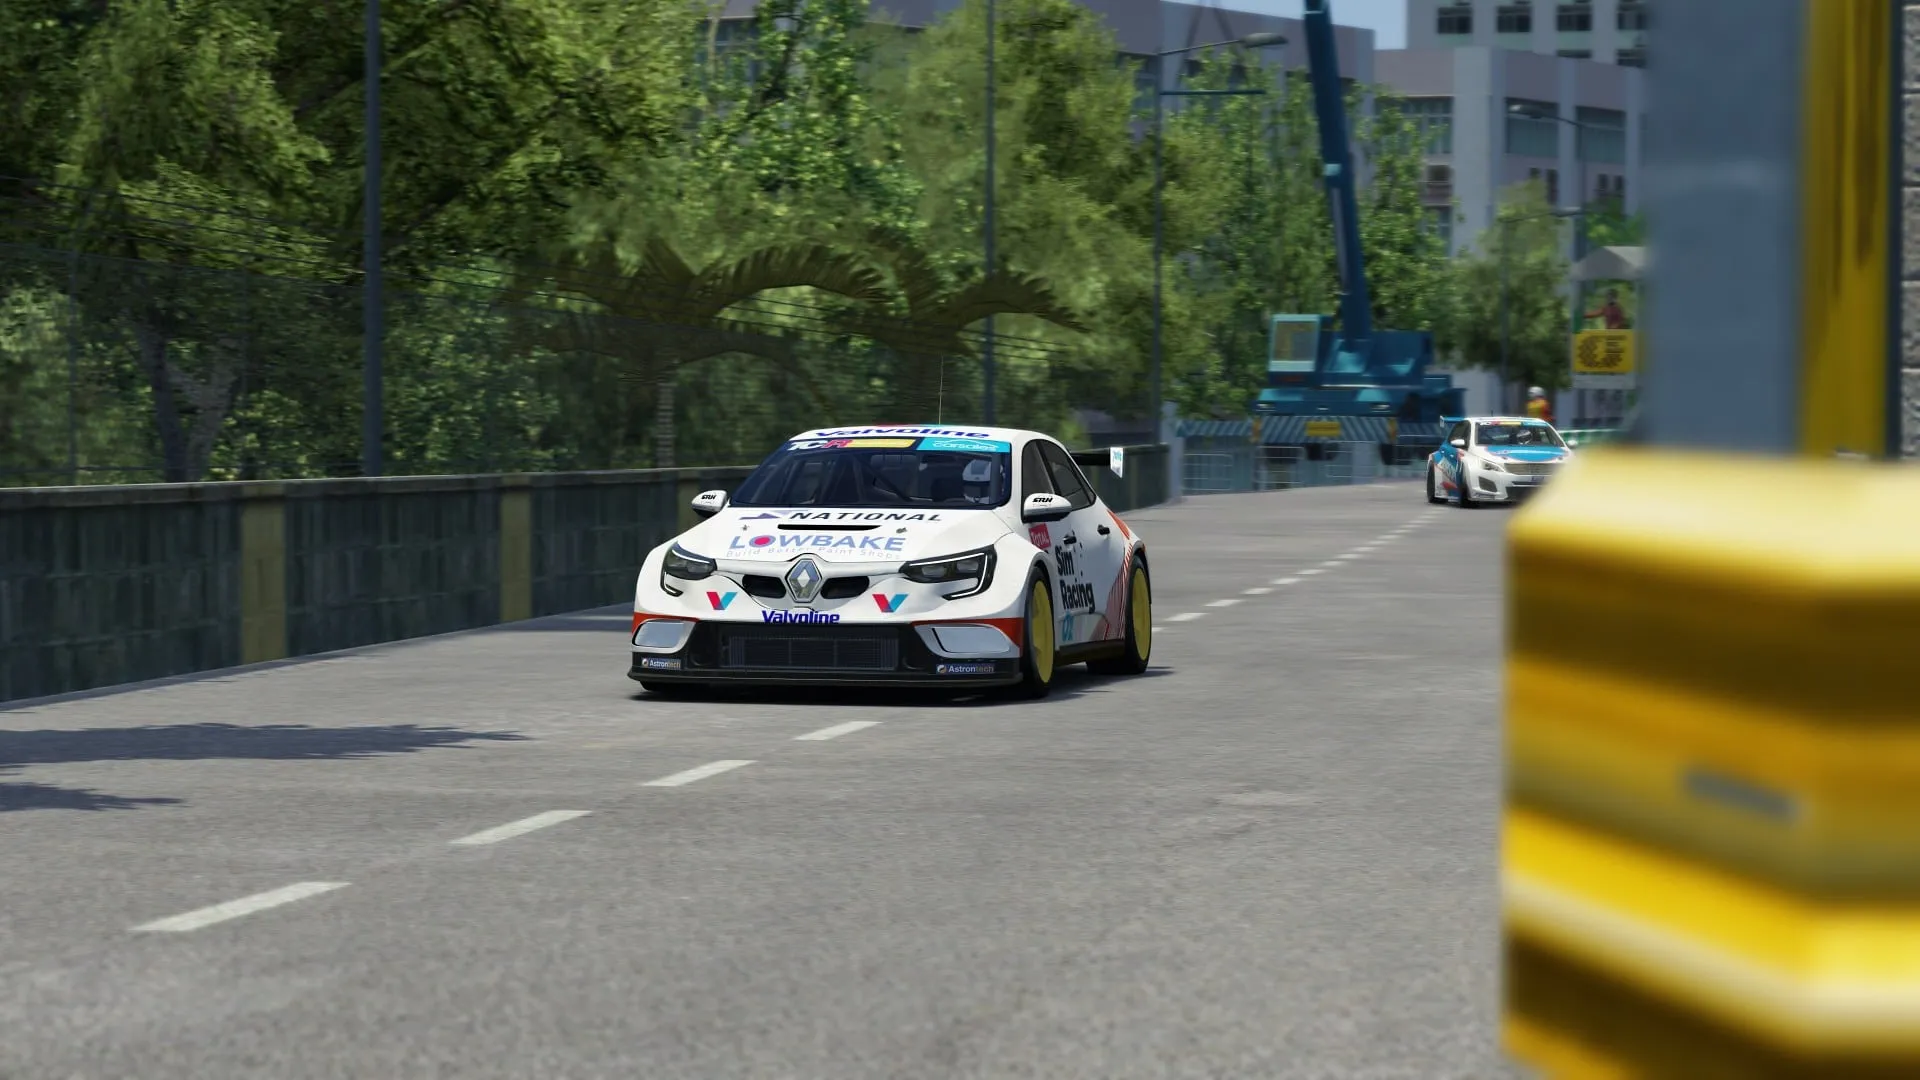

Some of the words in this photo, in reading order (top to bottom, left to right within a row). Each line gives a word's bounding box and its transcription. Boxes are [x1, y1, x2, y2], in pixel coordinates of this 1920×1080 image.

[815, 428, 990, 439] Valvoline
[789, 512, 943, 521] NATIONAL
[729, 535, 906, 551] LOWBAKE
[726, 549, 760, 558] Build
[818, 547, 853, 556] Paint
[1055, 545, 1075, 576] Sim
[1060, 581, 1095, 613] Racing
[762, 610, 840, 624] Valvoline
[948, 665, 995, 673] Astrontech
